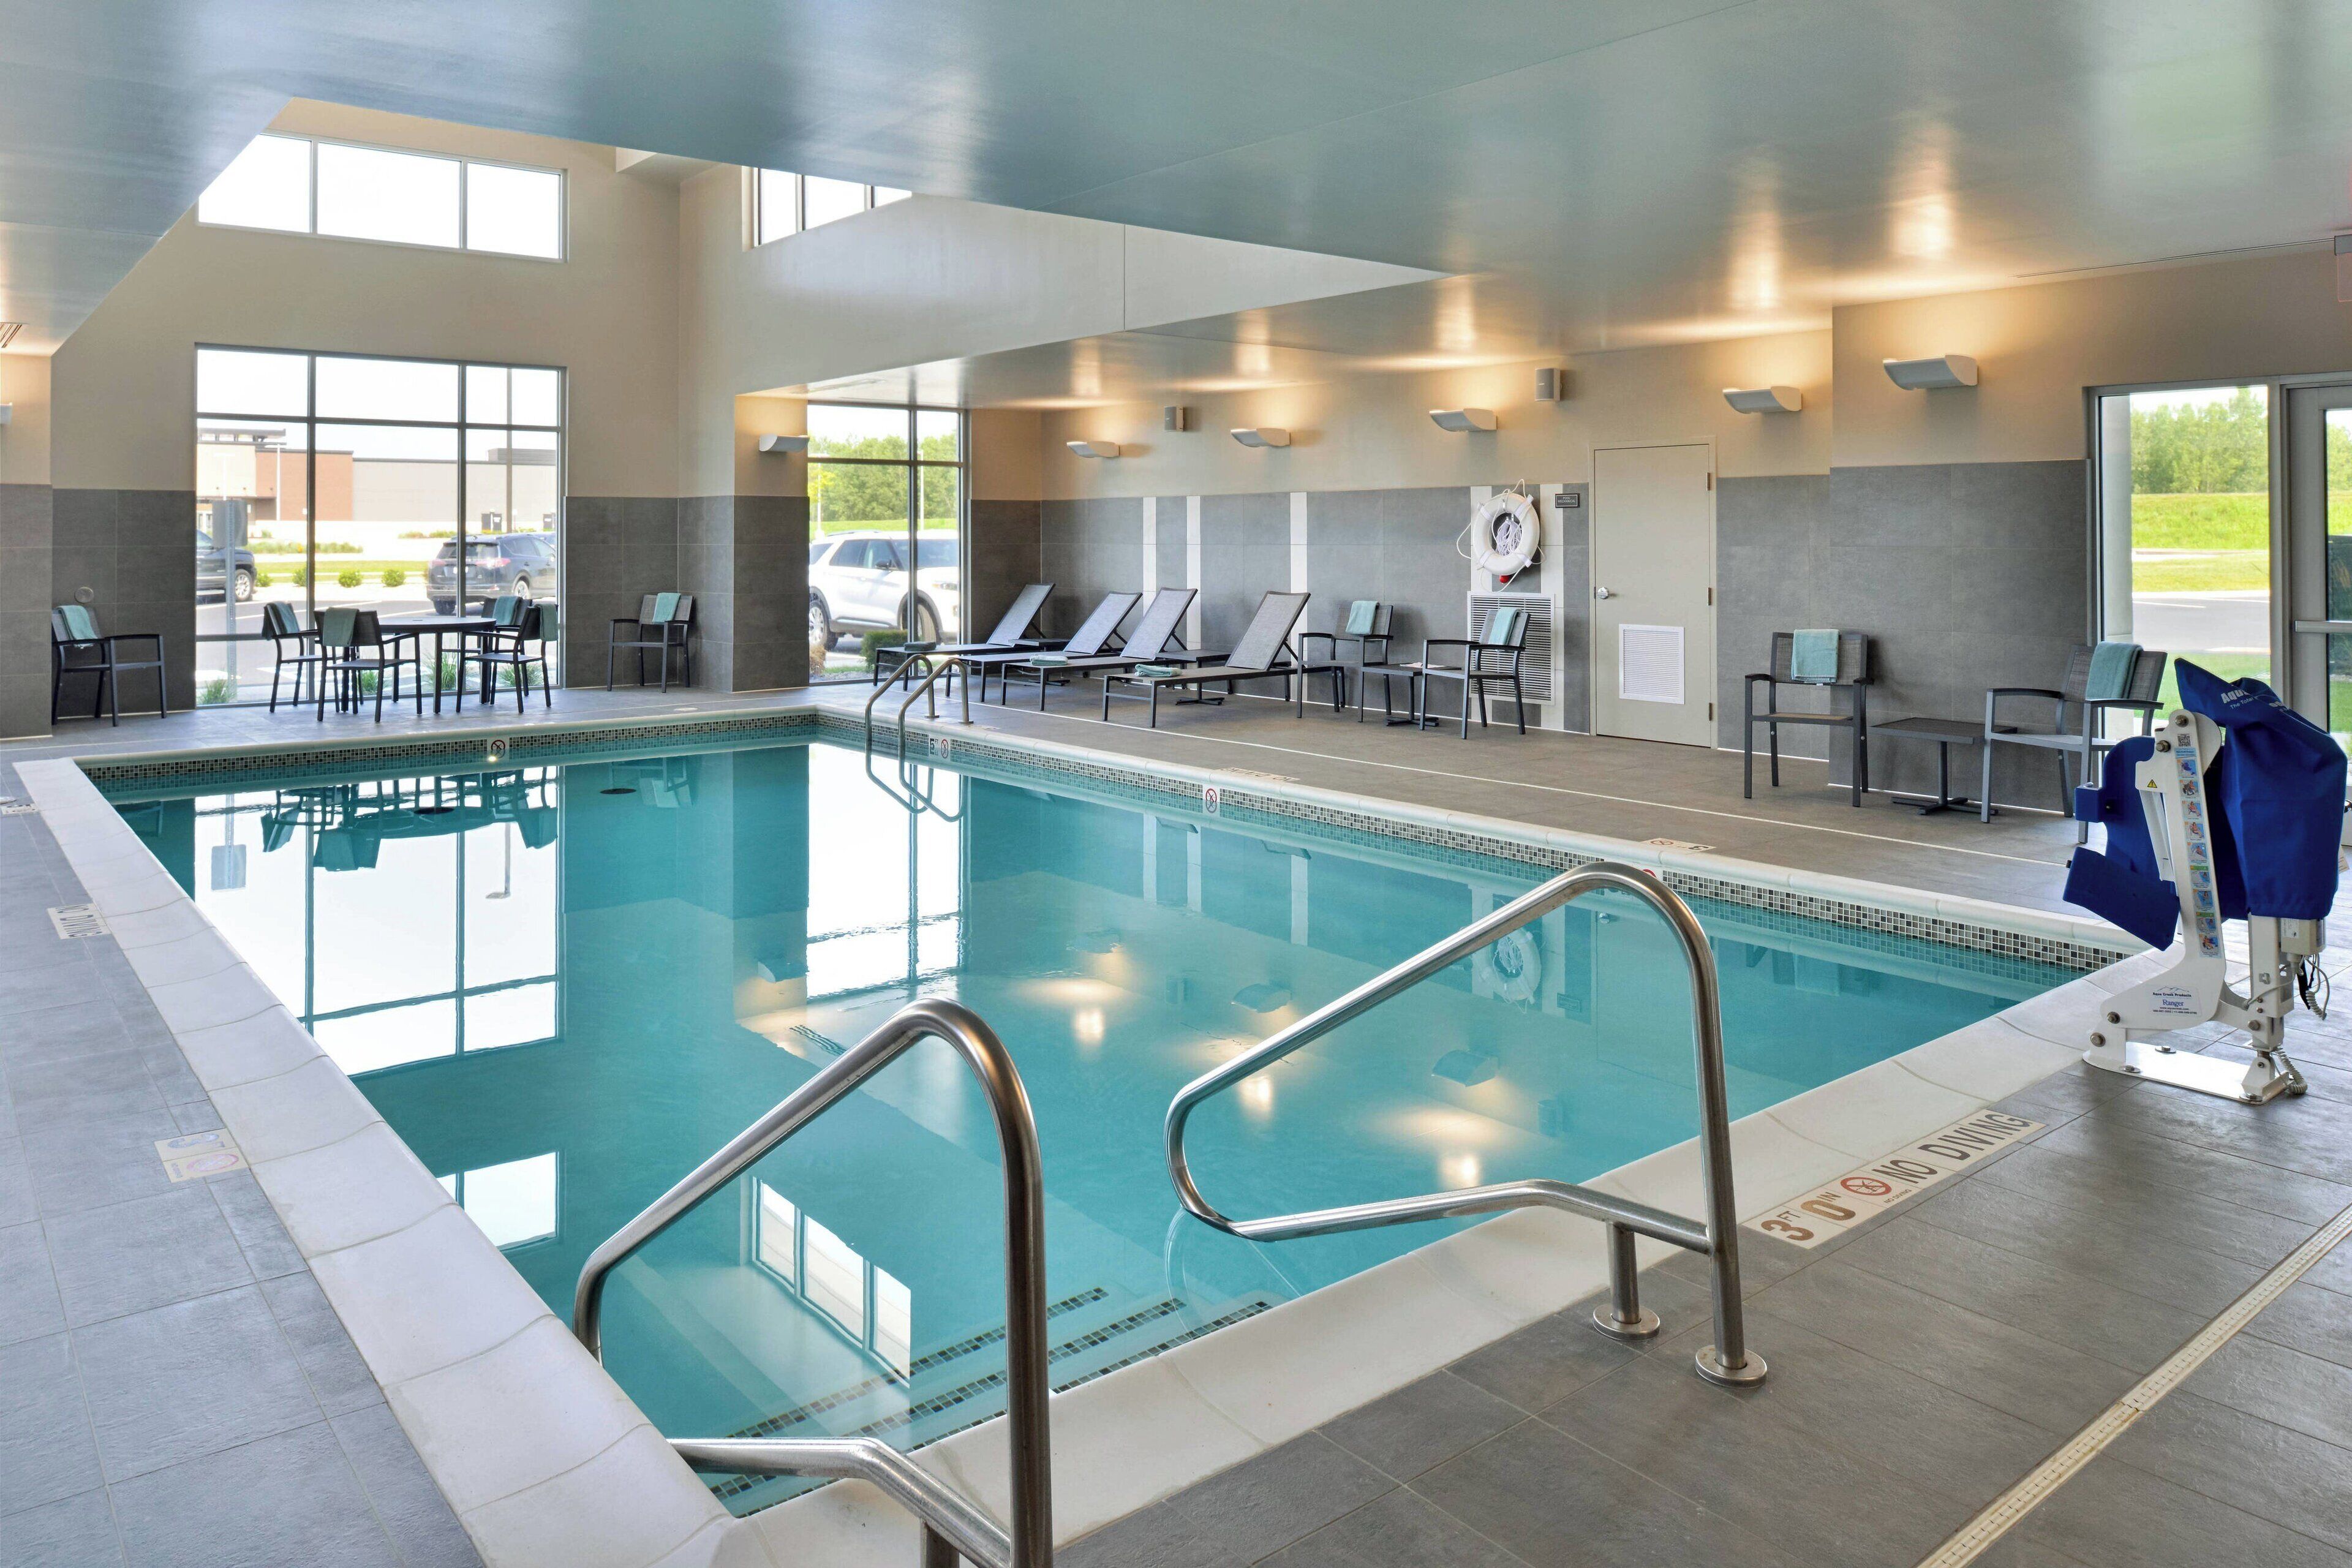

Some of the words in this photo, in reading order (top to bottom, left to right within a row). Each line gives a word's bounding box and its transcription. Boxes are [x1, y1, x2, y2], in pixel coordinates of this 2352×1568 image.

[55, 904, 90, 913] NO
[59, 914, 103, 937] DIVING
[1917, 1114, 2034, 1161] DIVING
[1872, 1159, 1939, 1185] NO
[1816, 1191, 1842, 1202] IN
[1893, 1189, 1912, 1199] DIVING
[1776, 1210, 1800, 1223] FT
[1800, 1199, 1856, 1221] 0
[1760, 1219, 1814, 1242] 3
